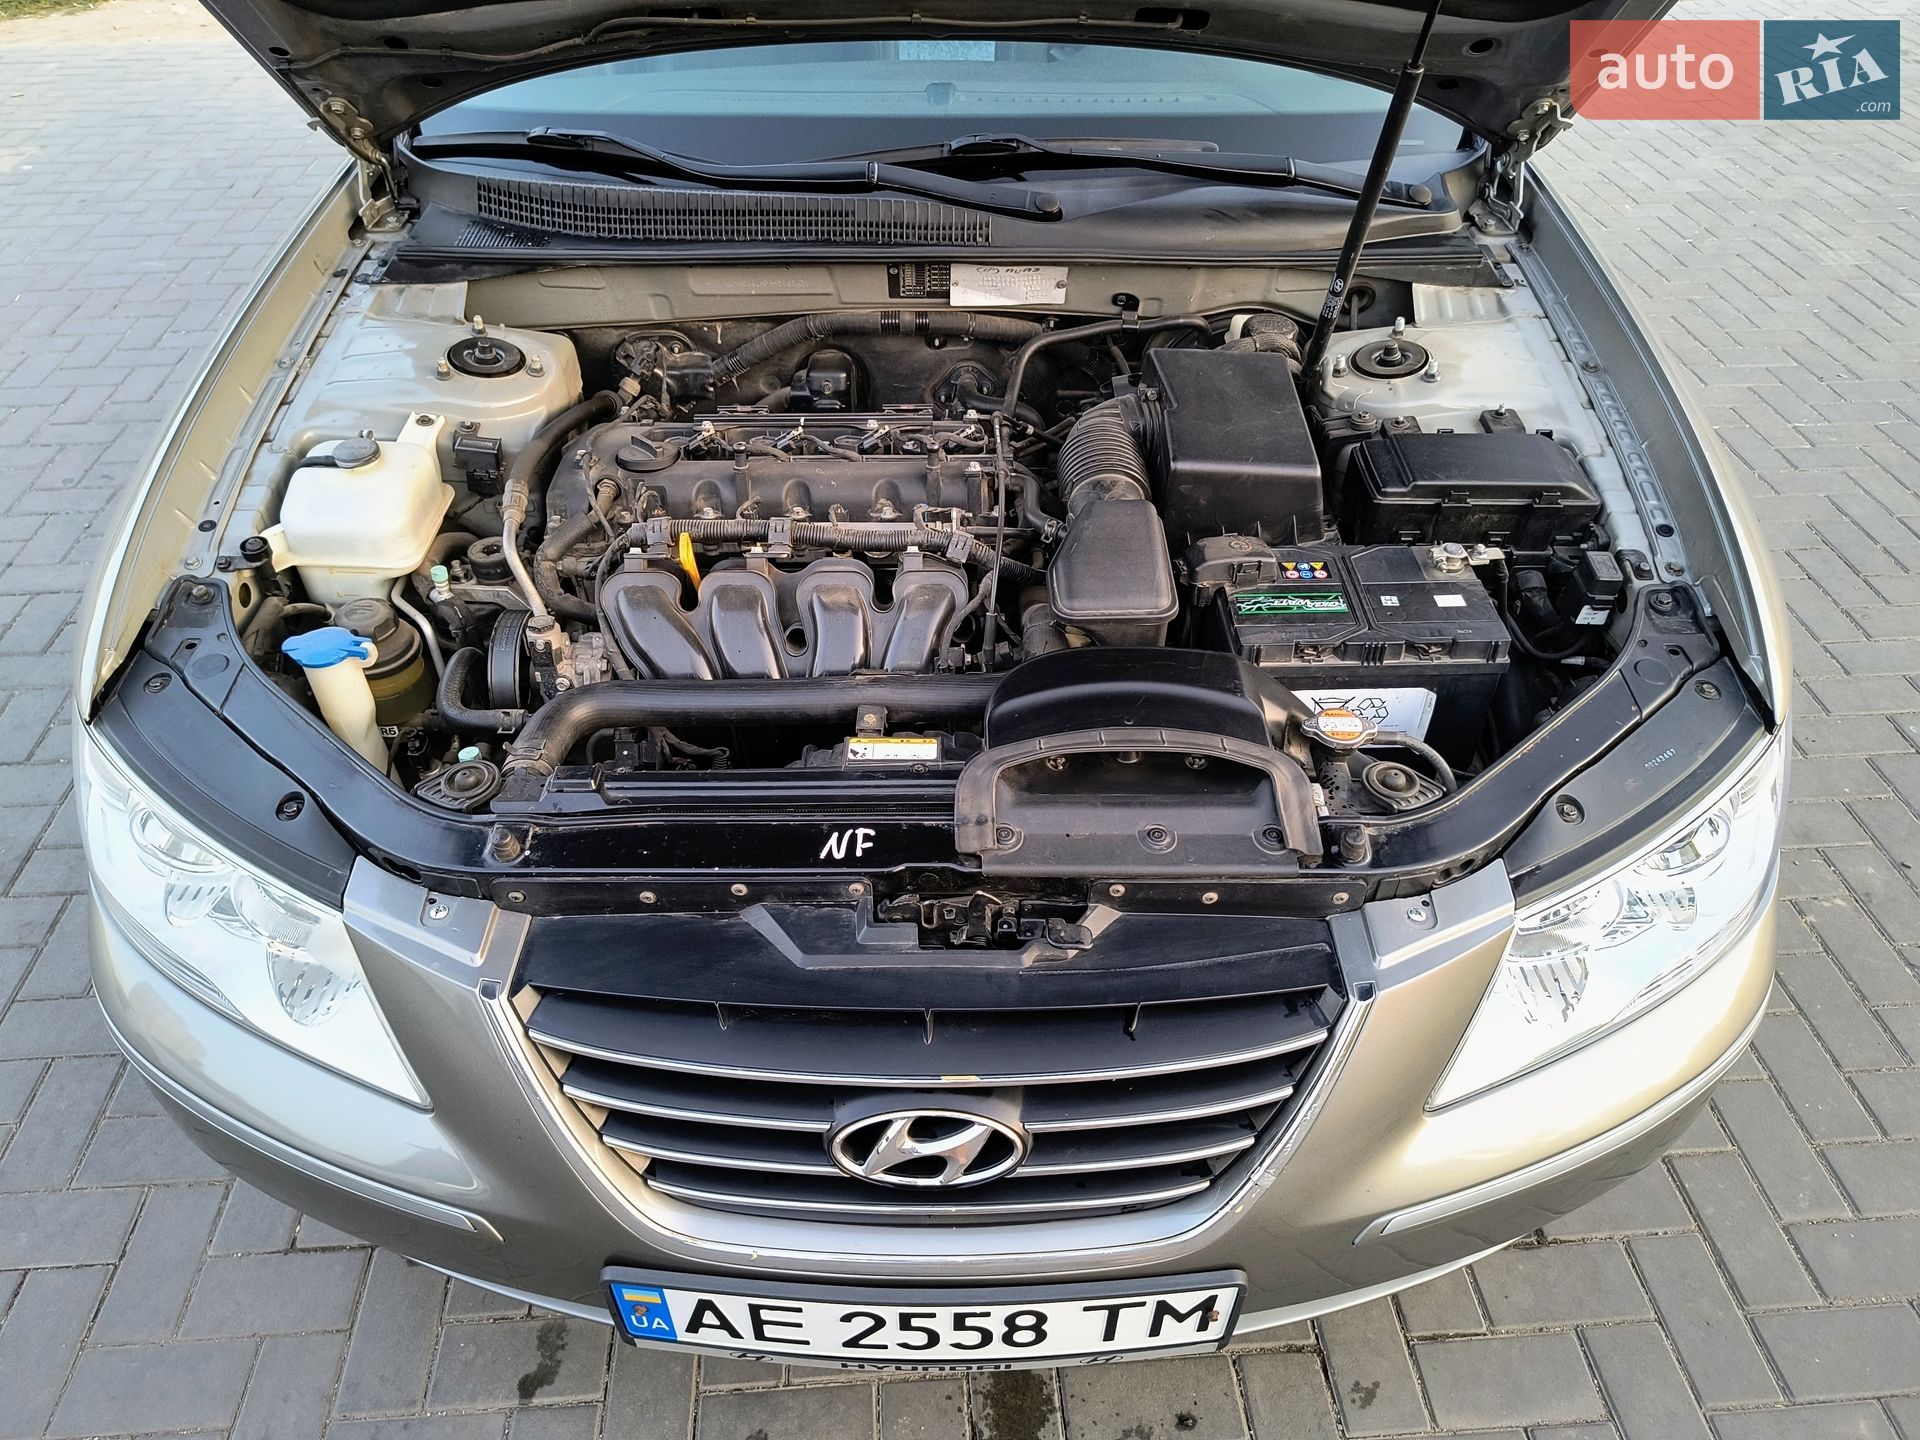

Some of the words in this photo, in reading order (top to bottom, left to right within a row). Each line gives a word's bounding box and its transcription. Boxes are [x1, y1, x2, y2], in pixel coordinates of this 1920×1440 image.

[819, 827, 876, 860] NF
[631, 1314, 670, 1331] UA
[684, 1298, 811, 1346] AE
[839, 1309, 1049, 1350] 2558
[1082, 1294, 1219, 1342] TM
[840, 1362, 1012, 1372] HYUNDAI
